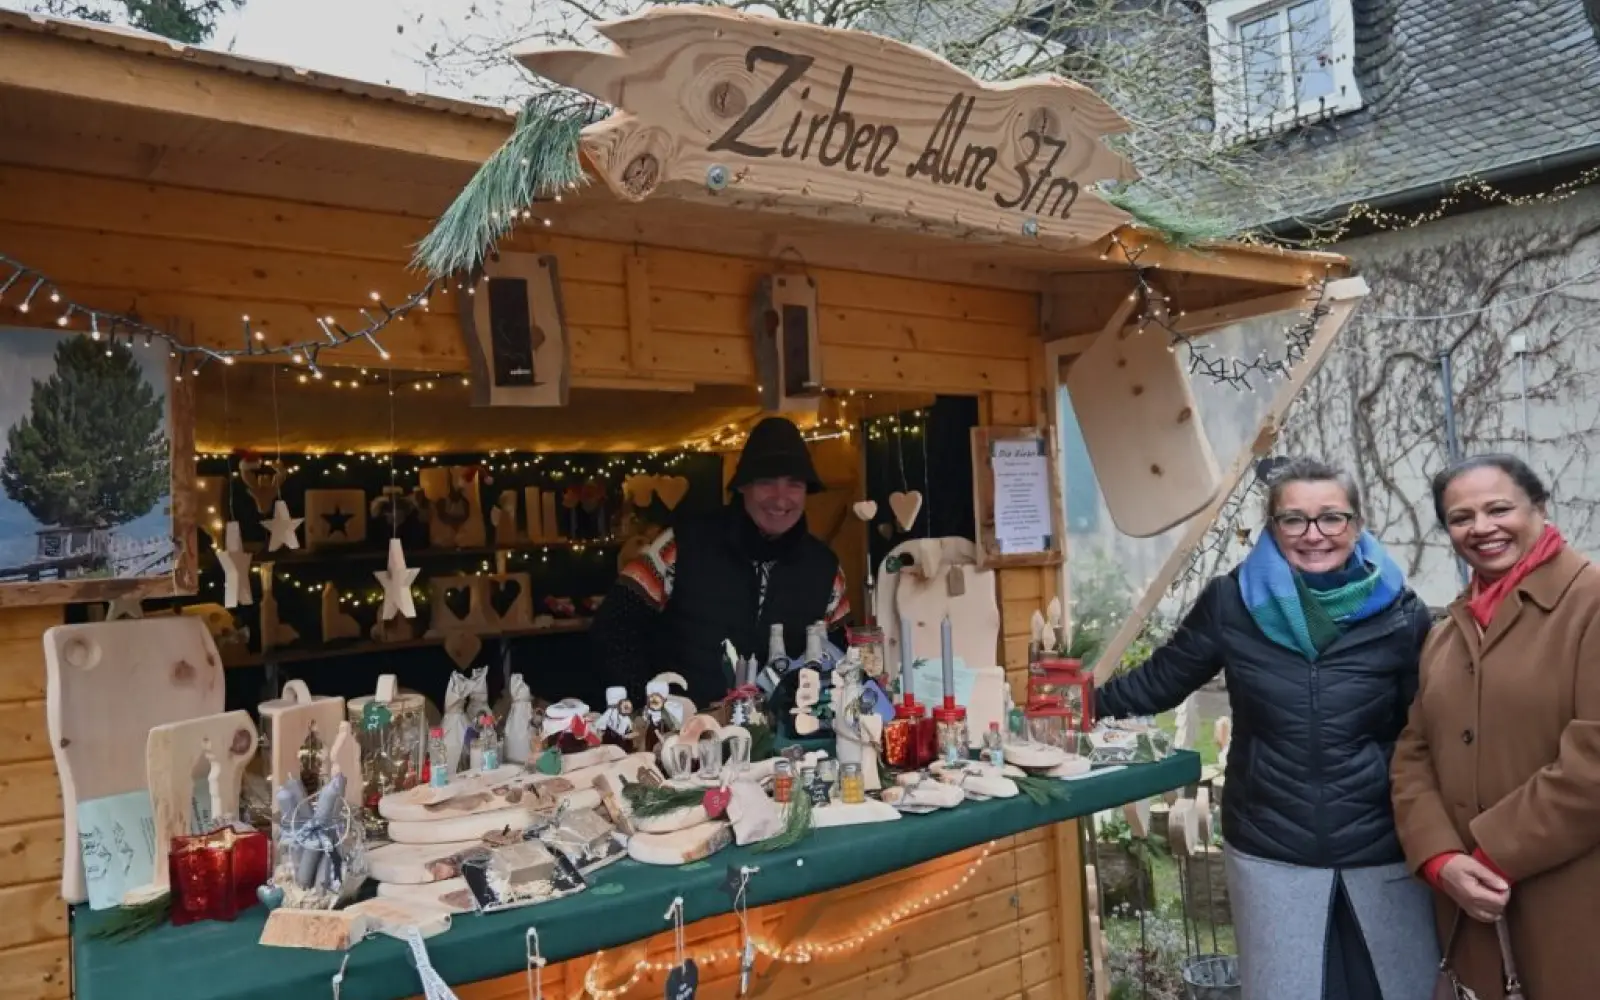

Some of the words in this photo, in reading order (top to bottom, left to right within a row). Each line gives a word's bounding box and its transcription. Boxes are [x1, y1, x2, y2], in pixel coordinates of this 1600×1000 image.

[707, 45, 899, 177] Zirben
[905, 91, 998, 192] Alm
[994, 130, 1080, 220] 37m
